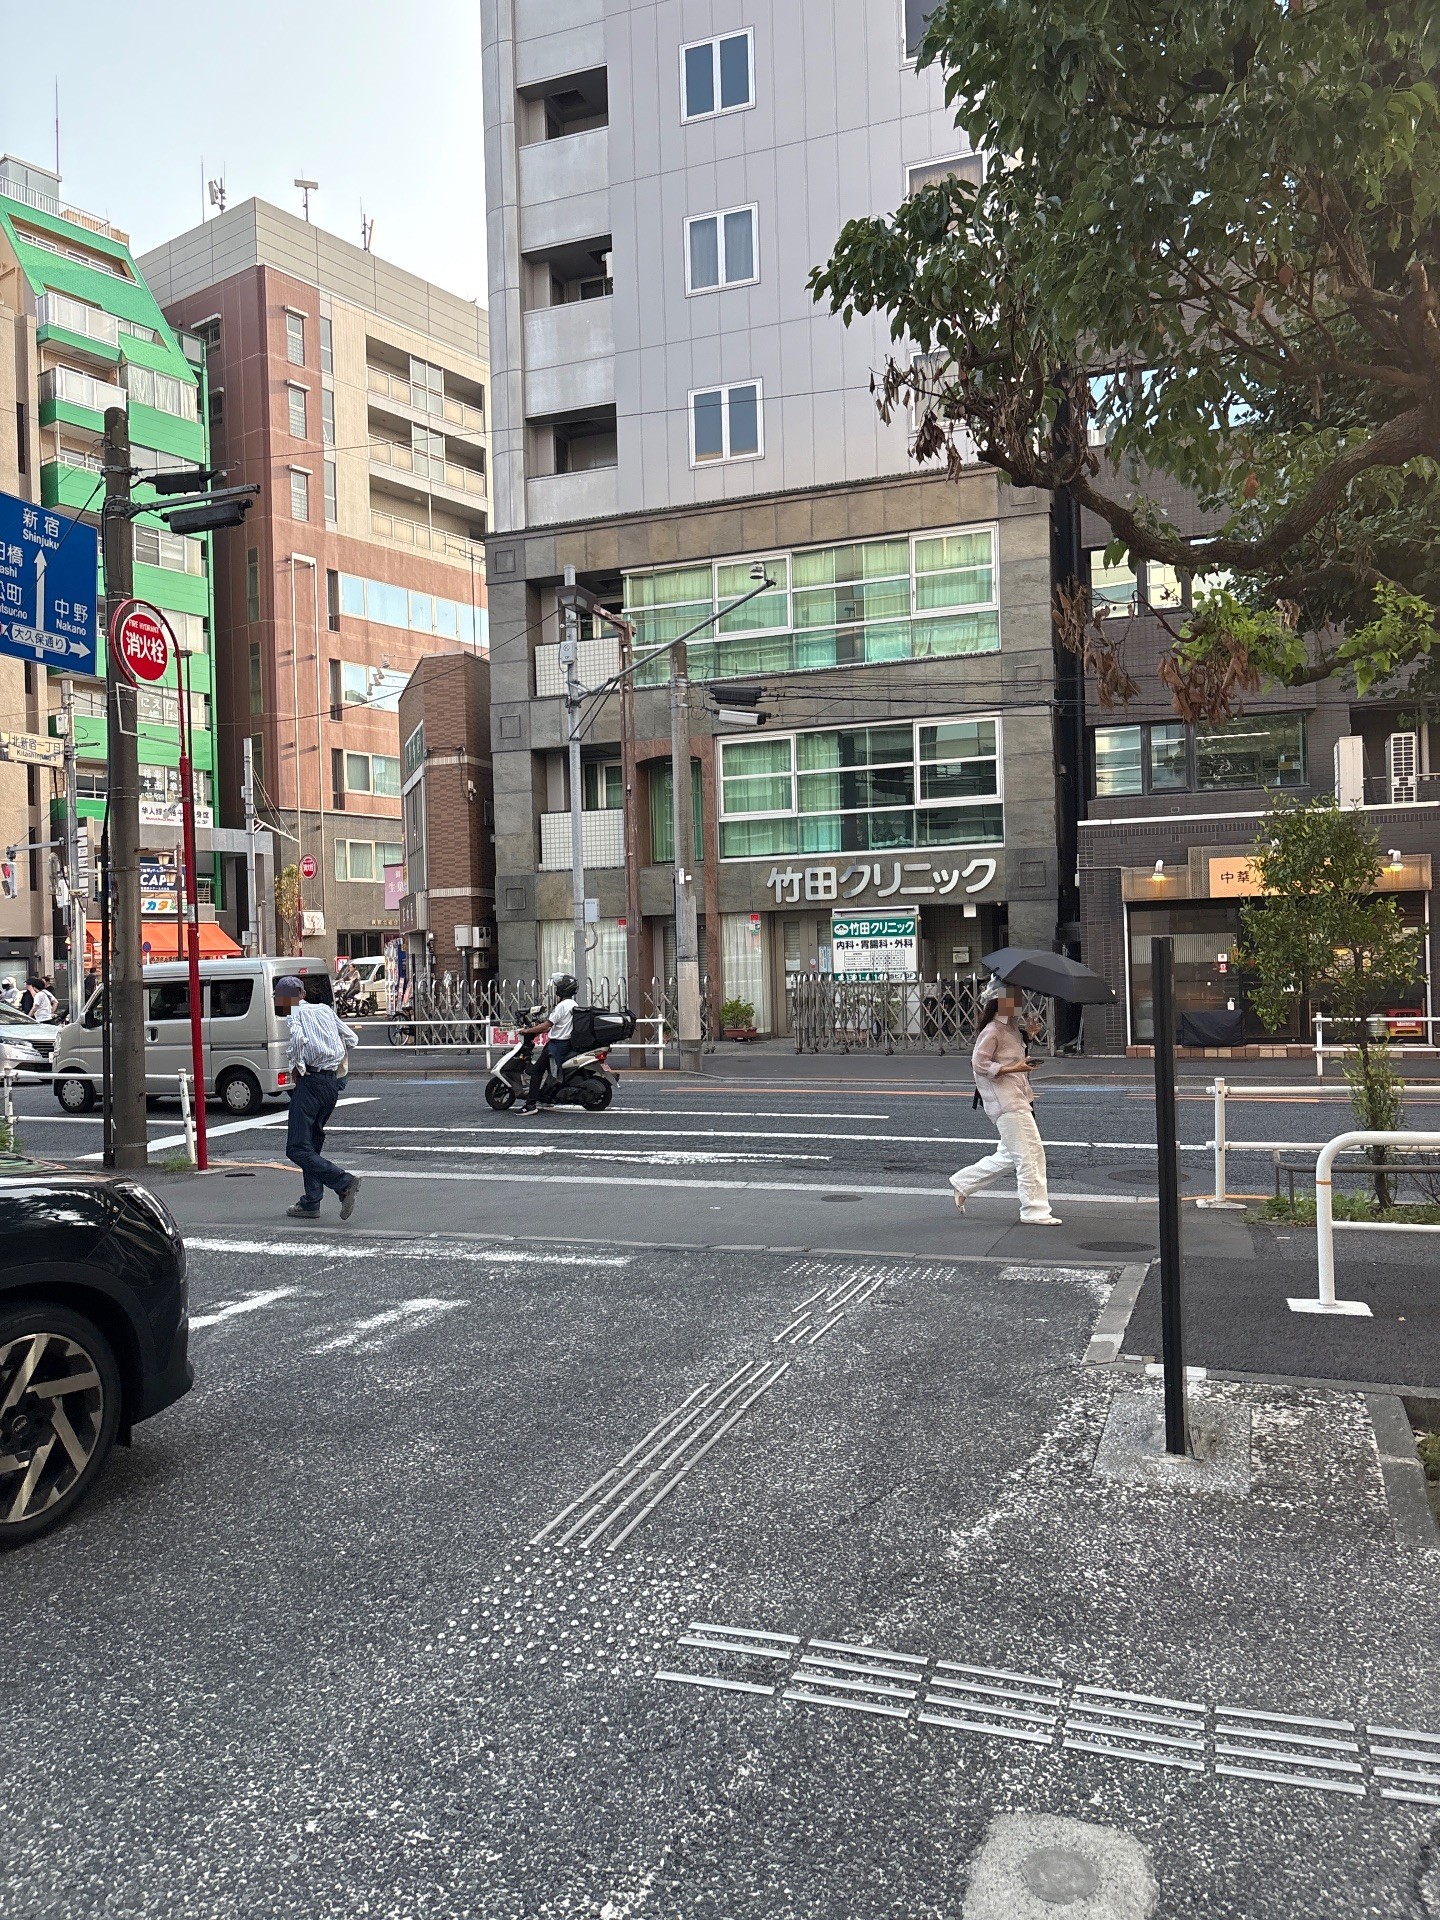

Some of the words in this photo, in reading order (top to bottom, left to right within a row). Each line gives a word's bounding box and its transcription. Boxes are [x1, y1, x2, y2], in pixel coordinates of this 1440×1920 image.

[23, 508, 60, 538] 新宿
[23, 528, 60, 550] Shinjuku
[55, 599, 88, 623] 中野
[56, 618, 86, 636] Nakano
[128, 619, 139, 629] FIRE
[14, 628, 64, 650] 大久保通り
[125, 630, 165, 664] 消火栓
[766, 858, 997, 903] 竹田クリニック
[849, 921, 914, 935] 竹田クリニック
[836, 939, 913, 950] 内科・胃腸科・外科
